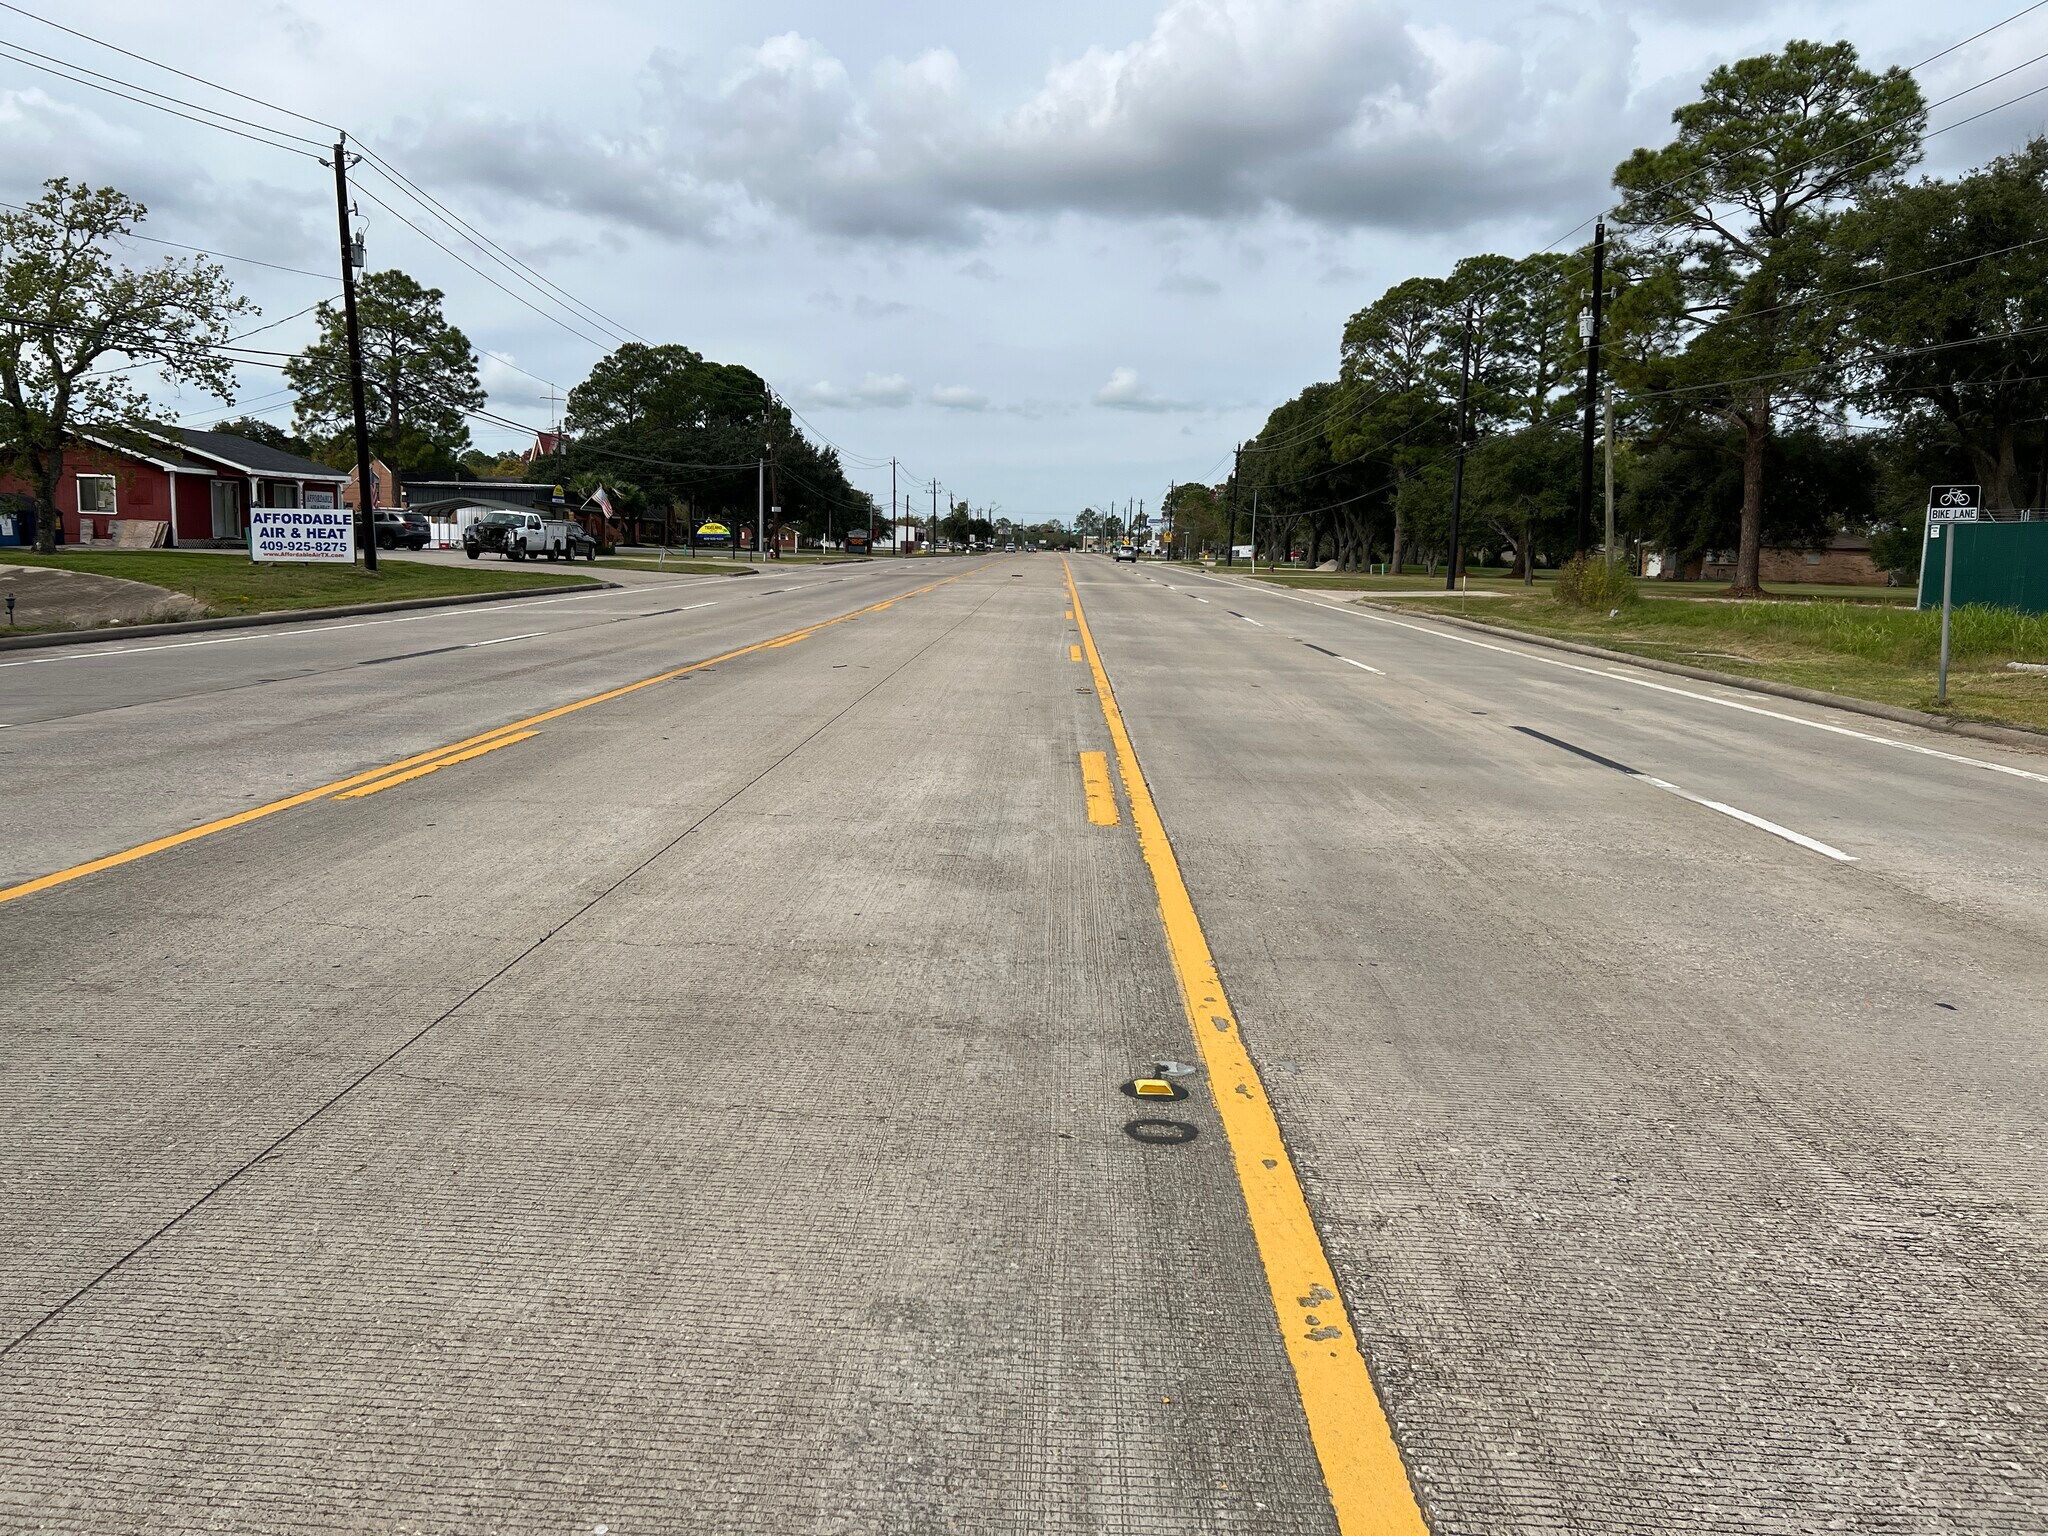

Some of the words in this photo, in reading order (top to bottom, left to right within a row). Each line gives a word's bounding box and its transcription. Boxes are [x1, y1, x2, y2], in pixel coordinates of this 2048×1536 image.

[253, 513, 352, 525] AFFORDABLE
[1932, 509, 1951, 519] BIKE
[1954, 509, 1975, 519] LANE
[259, 527, 286, 538] AIR
[290, 528, 301, 538] &
[306, 528, 347, 539] HEAT
[259, 541, 347, 552] 409-925-8275
